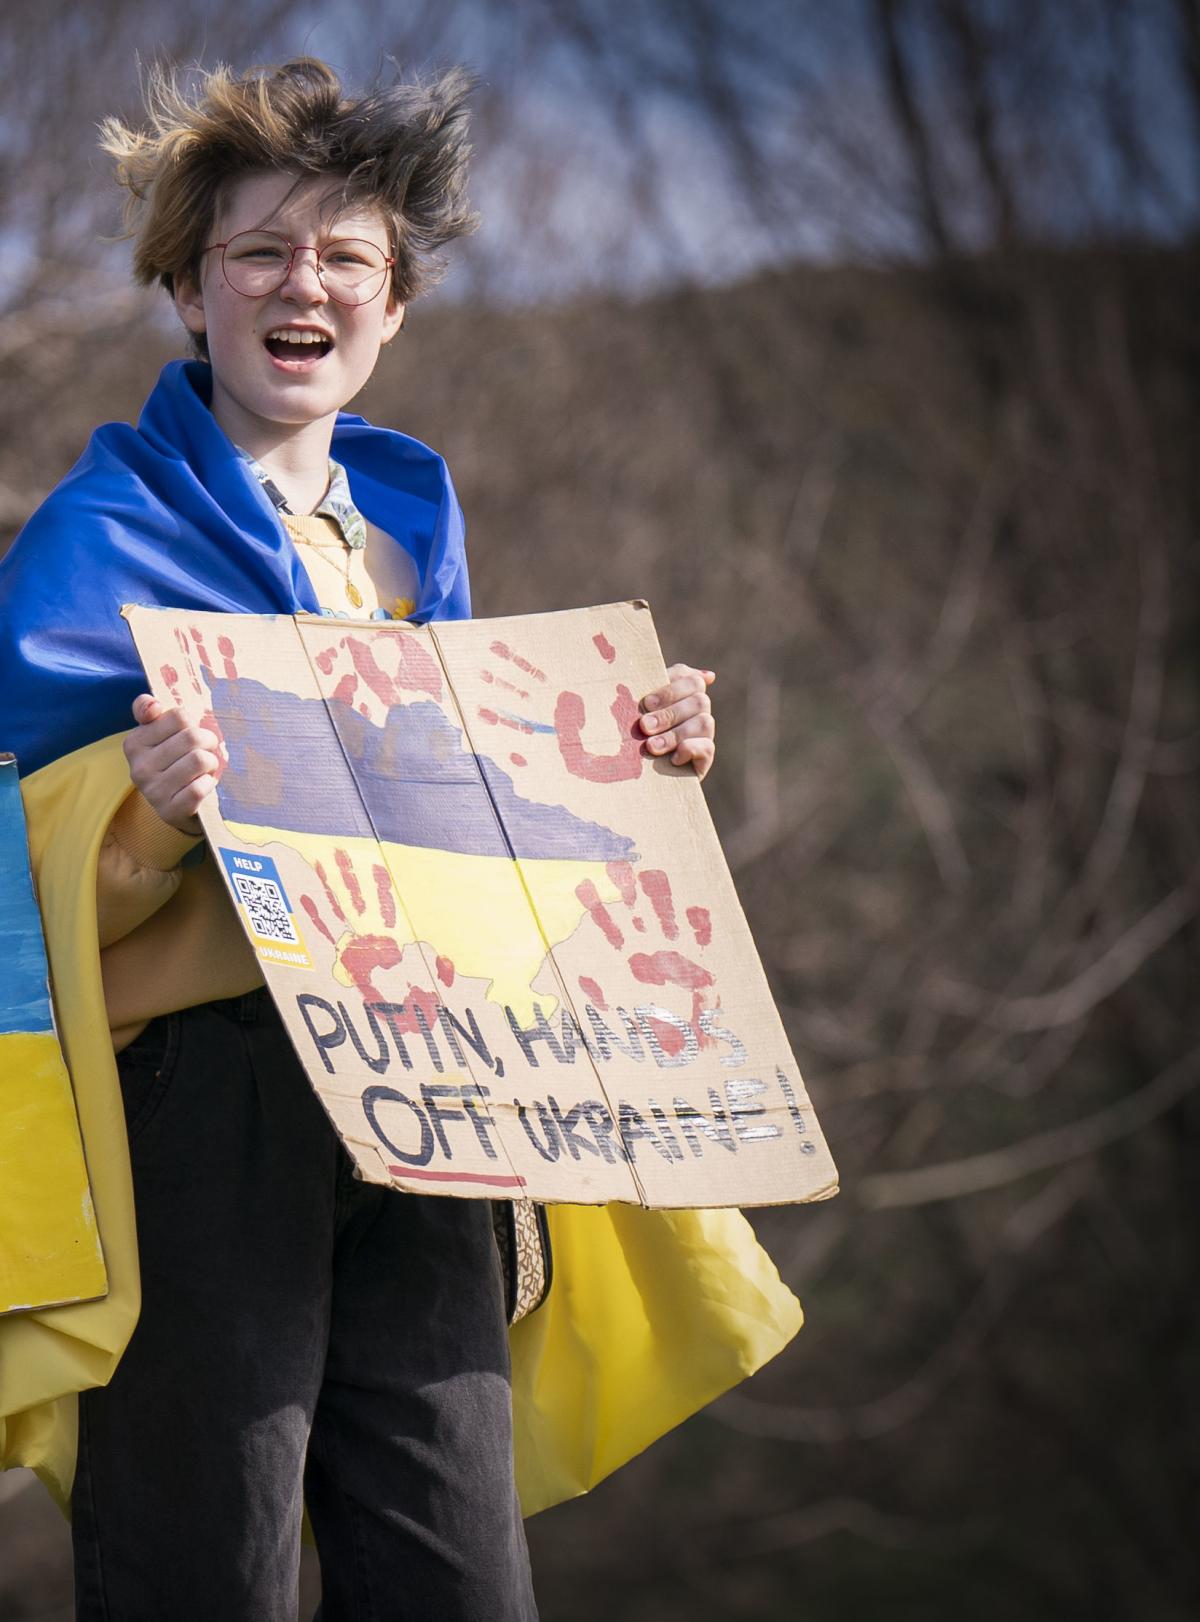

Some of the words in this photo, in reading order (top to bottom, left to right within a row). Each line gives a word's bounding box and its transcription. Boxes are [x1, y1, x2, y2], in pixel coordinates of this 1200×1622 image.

[233, 856, 263, 872] HELP
[260, 946, 308, 965] UKRAINE
[296, 993, 505, 1078] PUTIN,
[504, 1001, 749, 1070] HANDS
[360, 1083, 499, 1166] OFF
[513, 1064, 816, 1166] UKRAINE!
